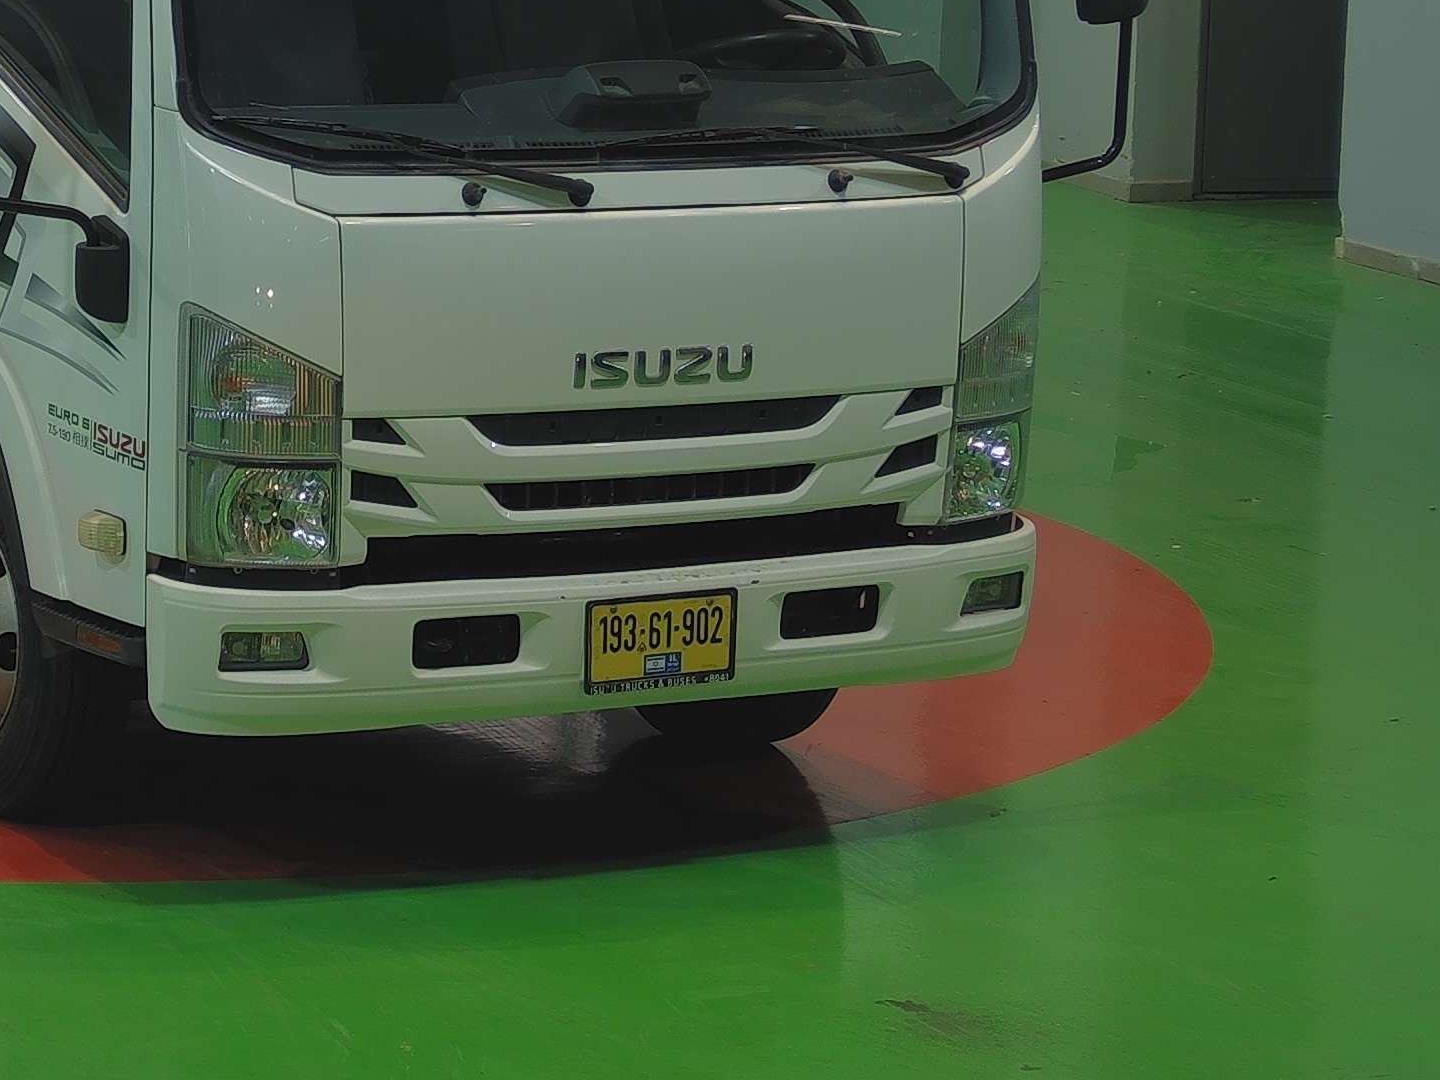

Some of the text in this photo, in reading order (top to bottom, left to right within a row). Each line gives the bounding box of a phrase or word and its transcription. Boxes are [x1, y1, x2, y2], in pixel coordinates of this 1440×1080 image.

[573, 344, 753, 389] ISUZU
[48, 403, 90, 430] EURO 6
[93, 422, 146, 459] ISUZU
[92, 442, 146, 471] SUMO
[620, 678, 655, 692] TRUCKS
[668, 675, 697, 688] BUSES
